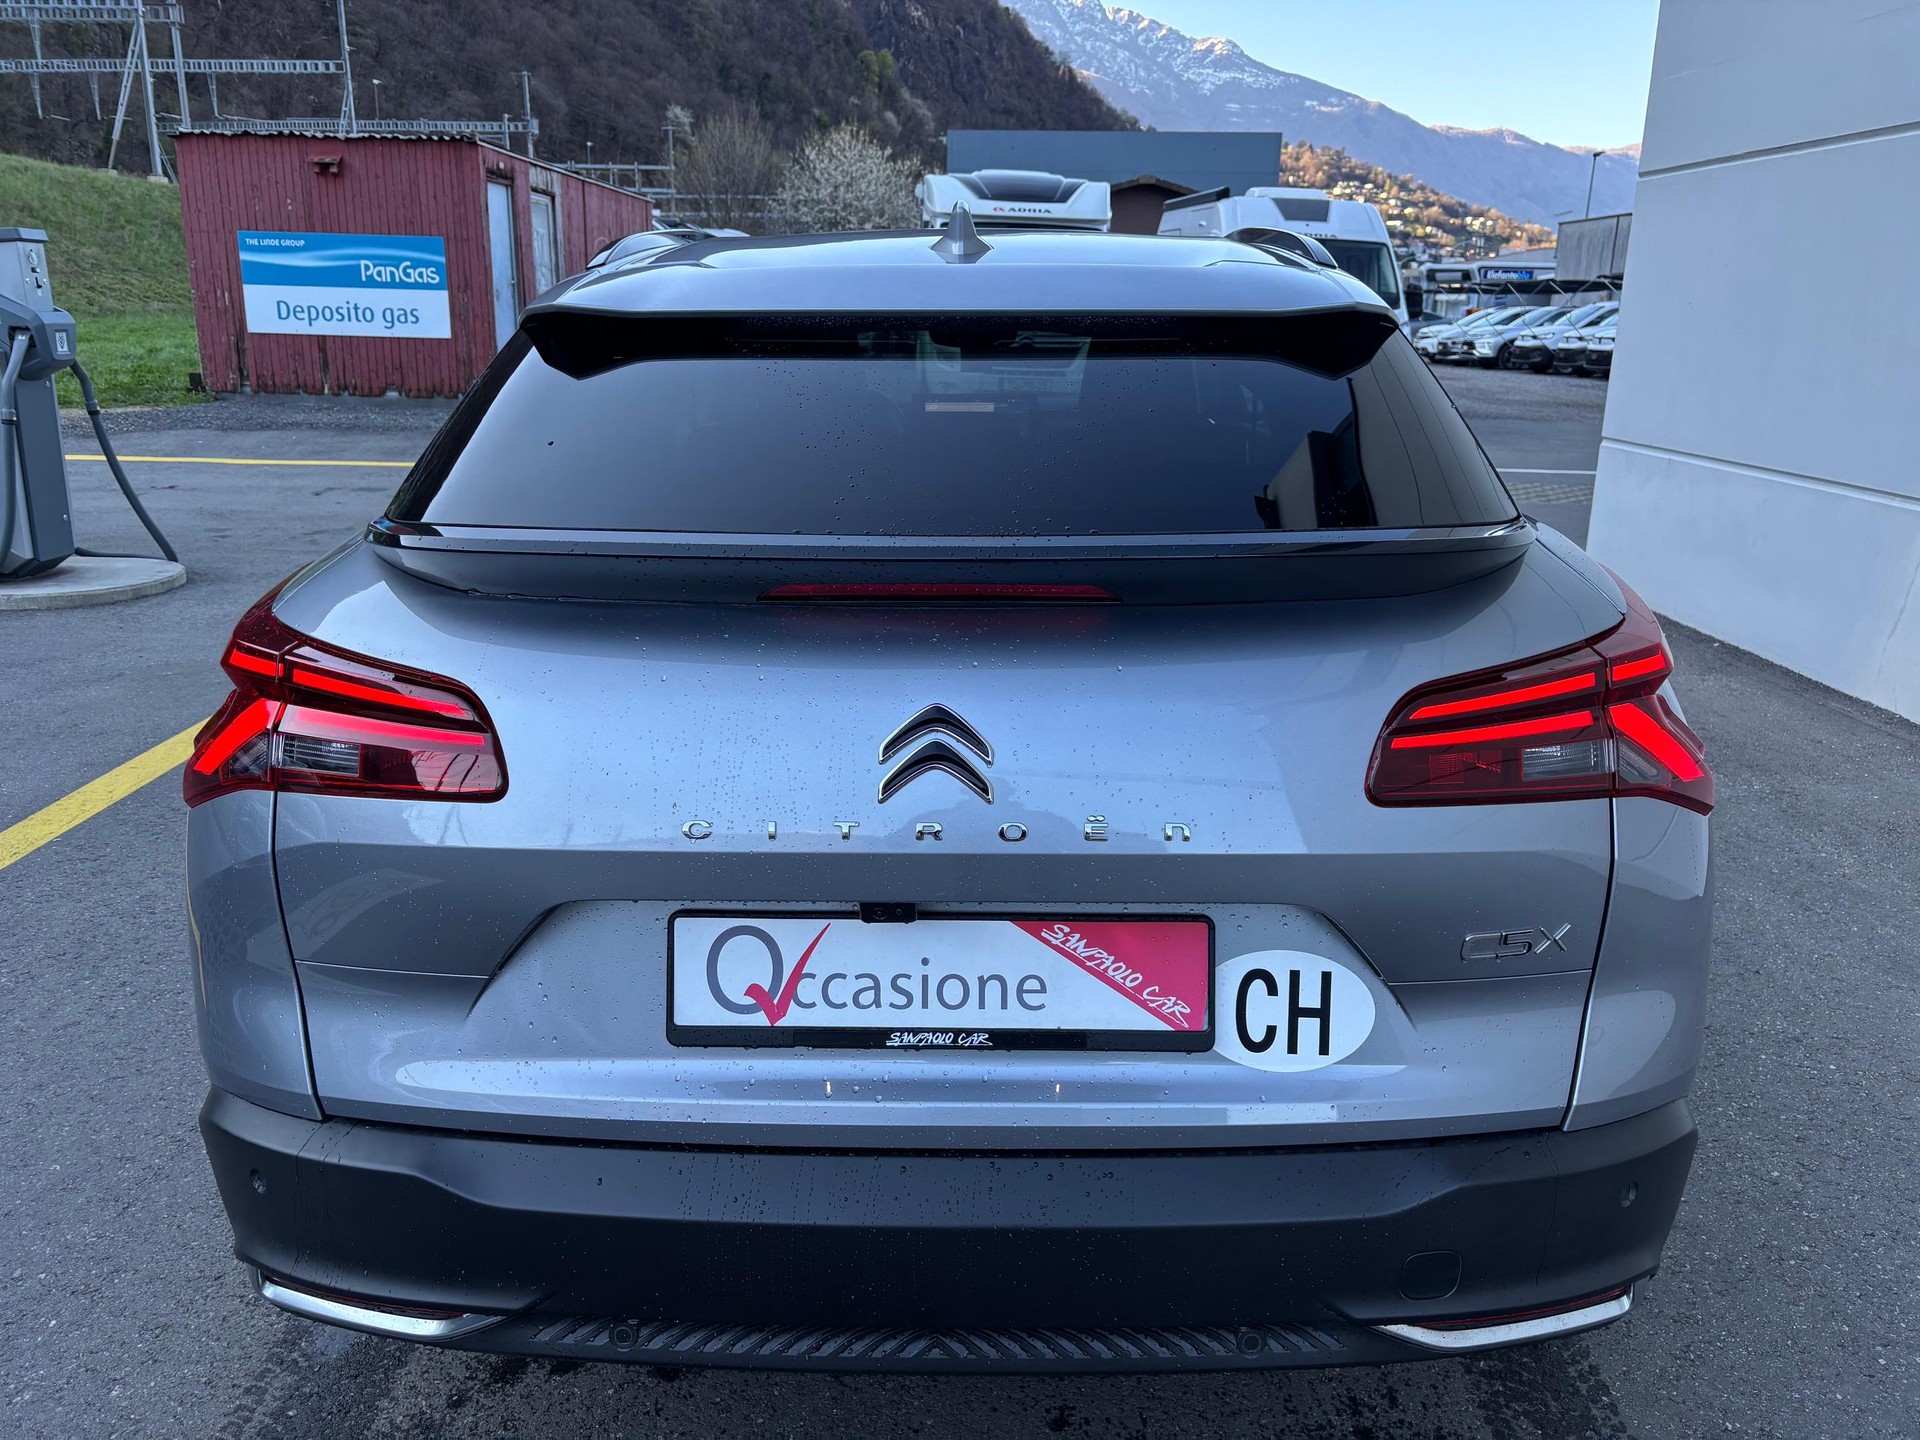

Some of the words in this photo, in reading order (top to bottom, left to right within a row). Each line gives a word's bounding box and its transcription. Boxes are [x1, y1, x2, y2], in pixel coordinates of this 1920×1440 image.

[245, 238, 259, 246] THE
[281, 239, 305, 247] GROUP
[360, 260, 440, 284] PanGas
[276, 300, 375, 326] Deposito
[382, 307, 420, 329] gas
[1041, 924, 1144, 990] SANPAOLO
[1142, 985, 1191, 1025] CAR
[1235, 968, 1333, 1056] CH
[886, 1032, 955, 1046] SANPAOLO
[957, 1032, 993, 1046] CAR
